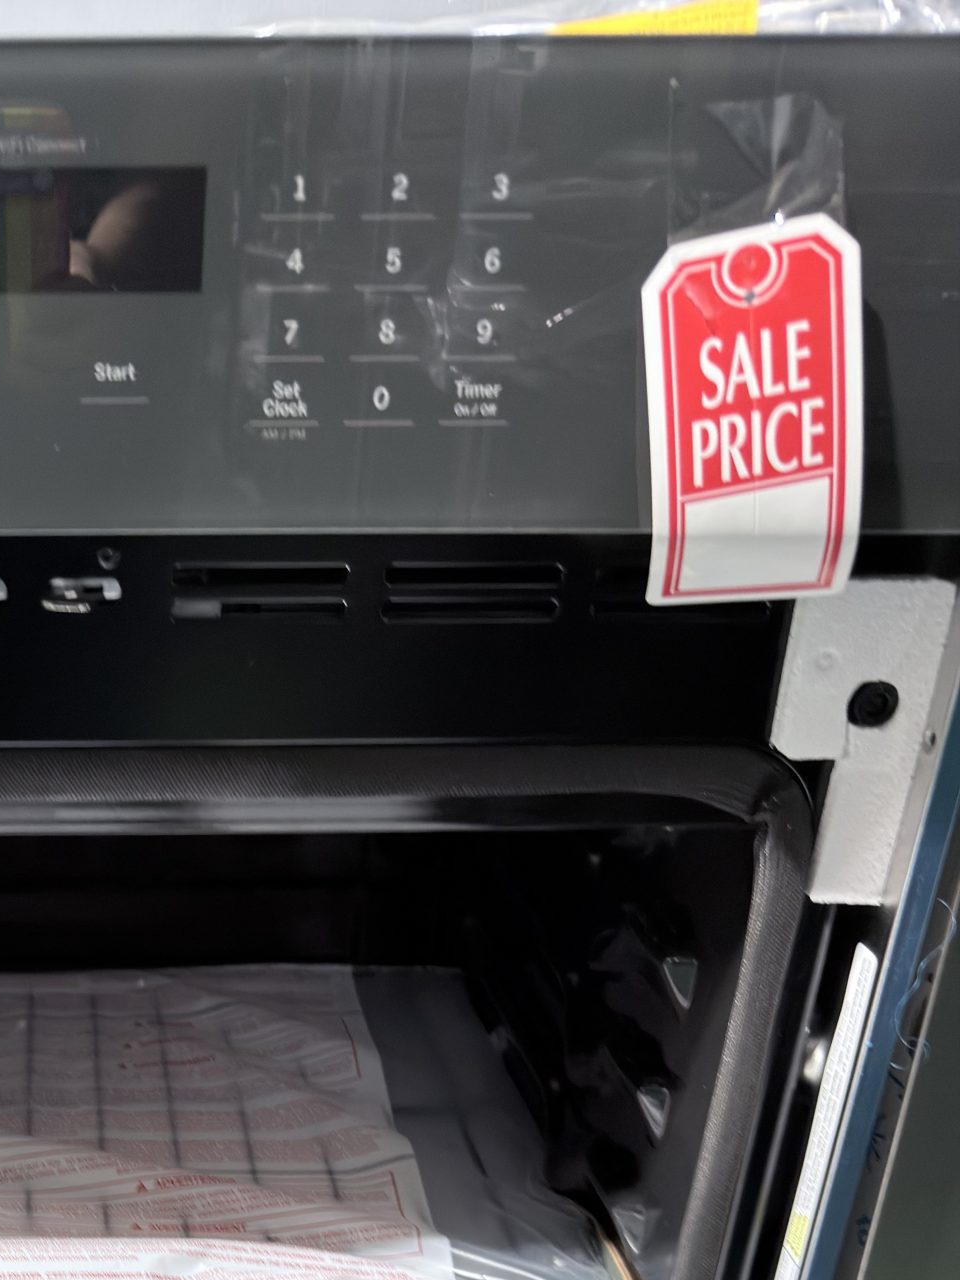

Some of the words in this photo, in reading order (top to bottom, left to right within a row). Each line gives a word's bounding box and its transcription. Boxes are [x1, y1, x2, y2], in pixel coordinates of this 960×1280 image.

[293, 174, 306, 201] 1
[391, 173, 408, 200] 2
[492, 173, 509, 200] 3
[286, 248, 304, 274] 4
[385, 247, 402, 273] 5
[484, 247, 501, 273] 6
[283, 320, 299, 345] 7
[378, 319, 396, 344] 8
[476, 319, 492, 345] 9
[94, 362, 137, 382] Start
[699, 319, 812, 410] SALE
[272, 380, 301, 399] Set
[373, 386, 391, 411] 0
[454, 379, 502, 399] Timer
[263, 398, 308, 418] Clock
[691, 397, 825, 488] PRICE
